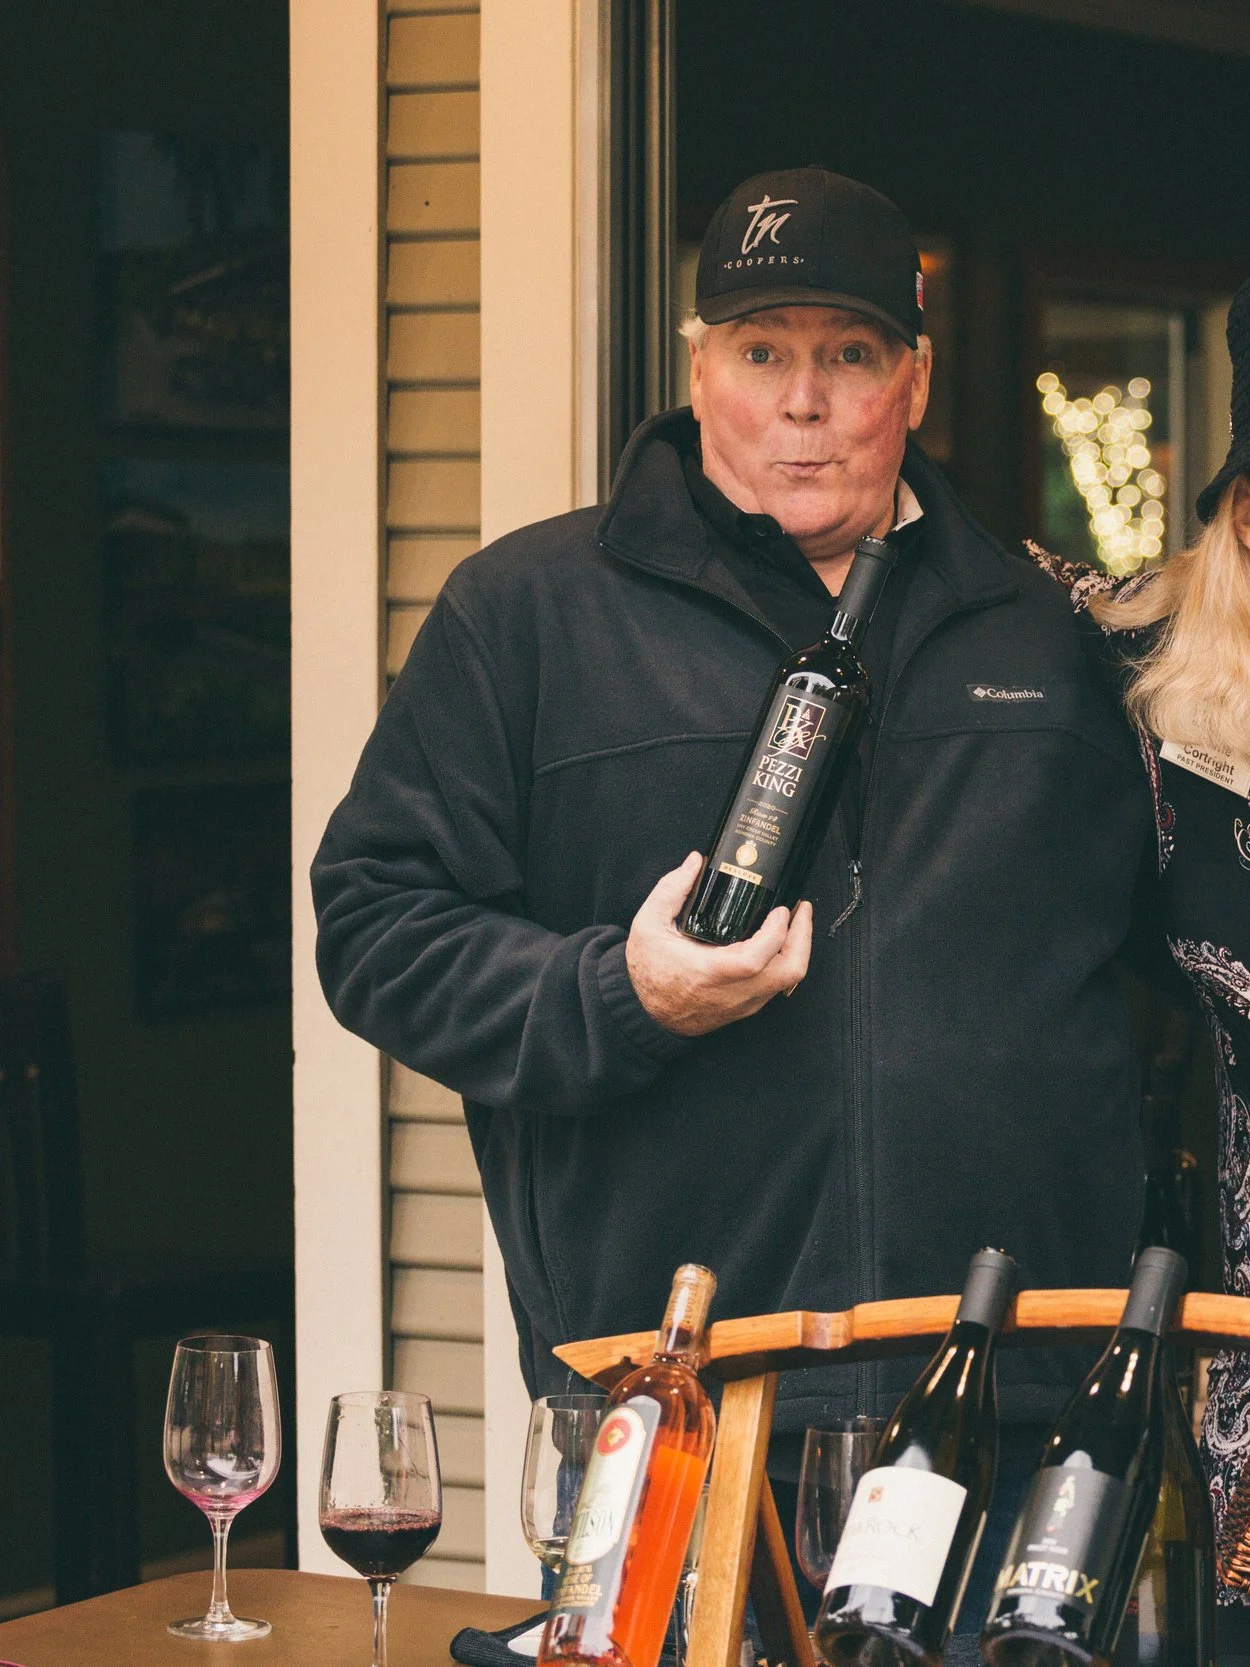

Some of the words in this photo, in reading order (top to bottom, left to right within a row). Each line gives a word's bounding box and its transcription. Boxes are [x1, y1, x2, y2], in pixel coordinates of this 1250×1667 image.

[987, 688, 1044, 700] Columbia
[759, 754, 803, 782] PEZZI
[1176, 753, 1194, 766] PAST
[1195, 763, 1235, 785] PRESIDENT
[1183, 744, 1235, 776] Cortright
[752, 771, 797, 798] KING
[758, 800, 776, 811] 2020
[739, 814, 781, 835] ZINFANDEL
[761, 831, 779, 842] VALLEY
[755, 835, 777, 847] COUNTY
[994, 1561, 1099, 1604] MATRIX
